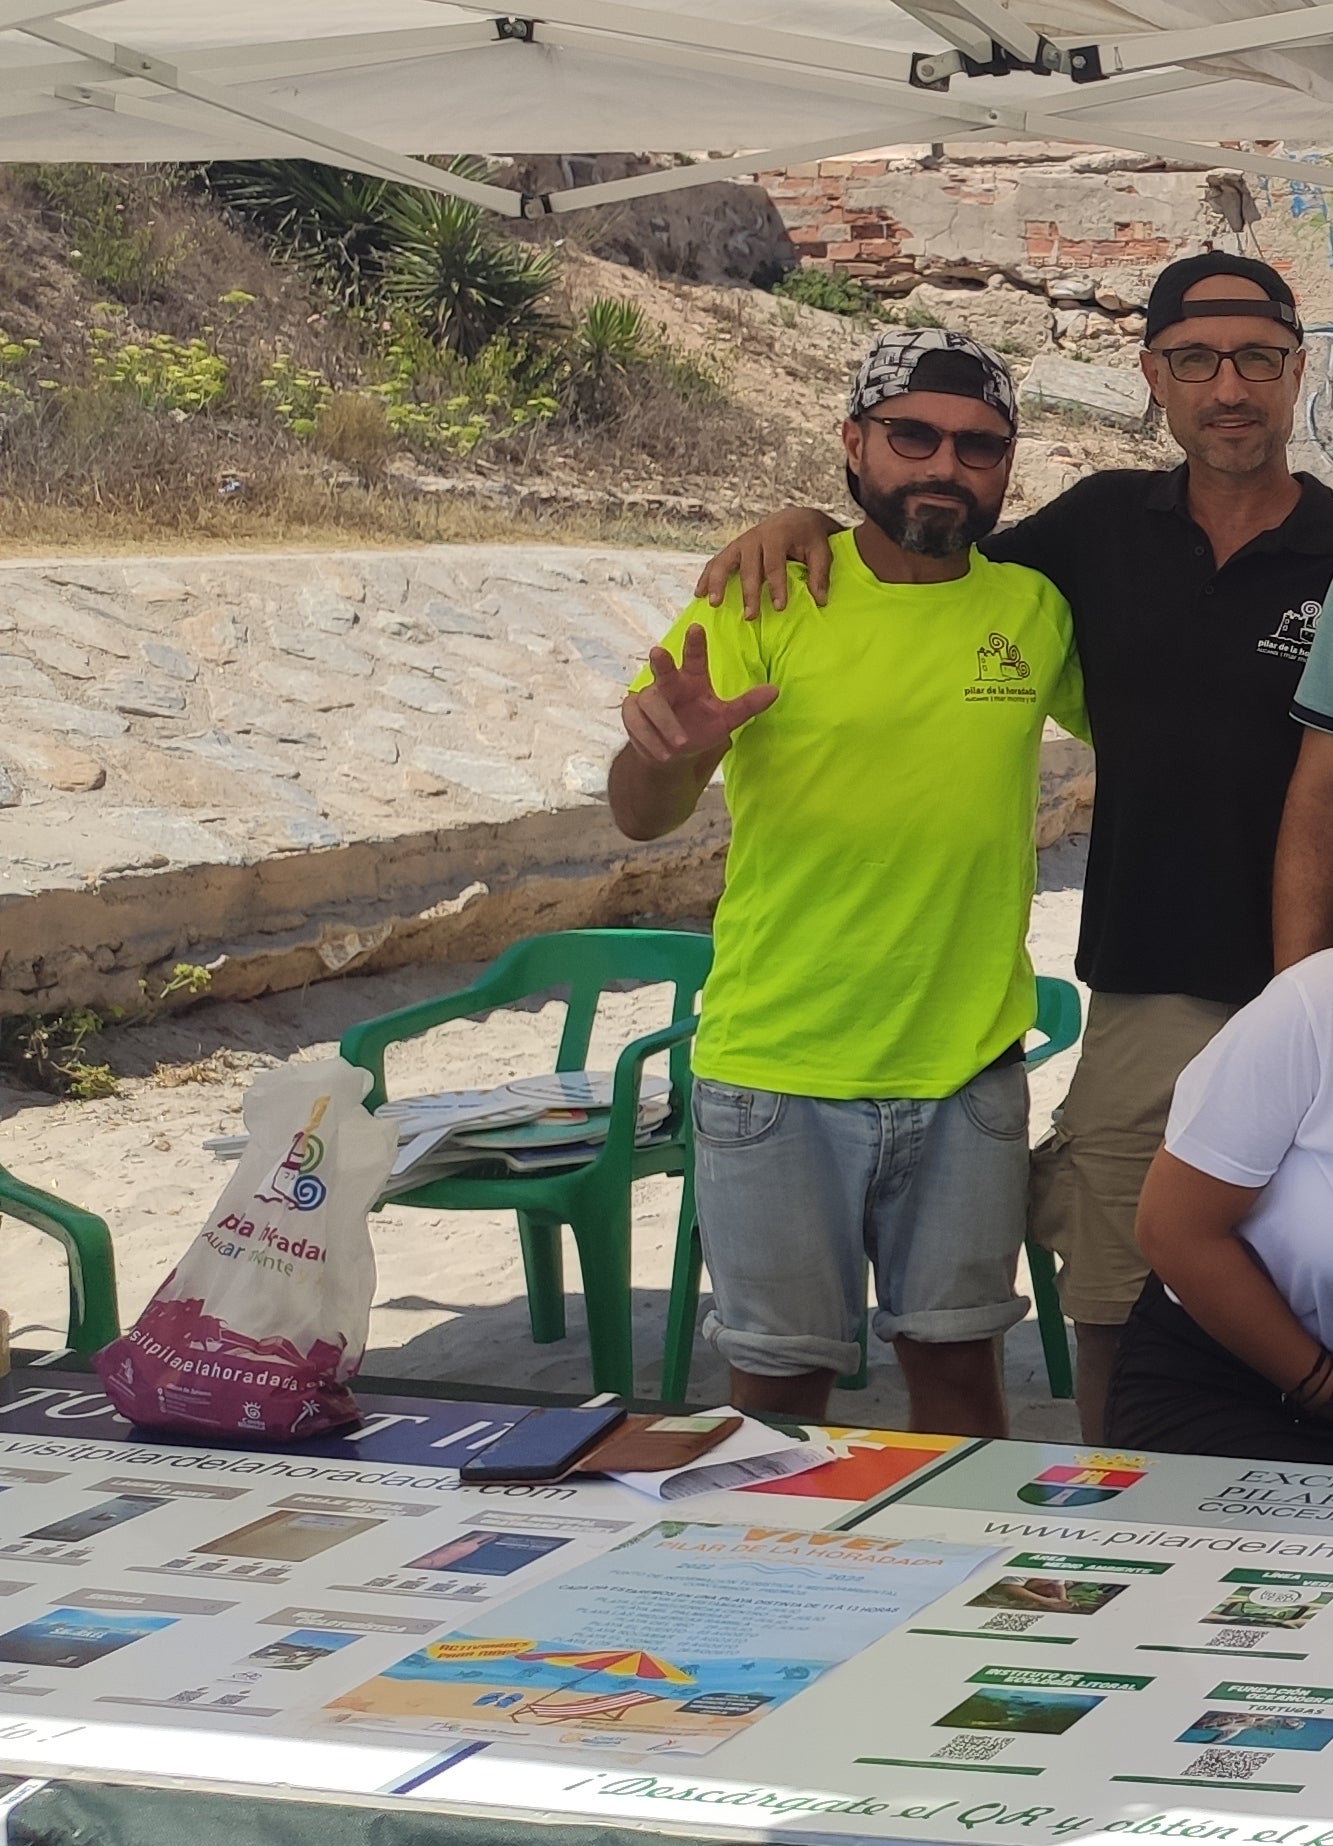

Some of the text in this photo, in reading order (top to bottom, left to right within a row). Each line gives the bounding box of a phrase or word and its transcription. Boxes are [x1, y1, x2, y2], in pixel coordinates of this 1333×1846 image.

[1258, 640, 1278, 649] pilar
[1279, 643, 1289, 651] de
[1290, 645, 1298, 654] la
[965, 686, 984, 696] pilar
[987, 686, 996, 694] de
[653, 1541, 944, 1566] PILAR DE LA HORADADA
[1087, 1565, 1154, 1574] AMBIENTE
[717, 1595, 749, 1604] PLAYA
[751, 1600, 798, 1610] DISTINTA
[984, 1668, 1085, 1681] INSTITUTO DE
[1077, 1680, 1139, 1691] LITORAL
[1227, 1684, 1312, 1696] FUNDACIÓN
[1247, 1705, 1327, 1715] TORTUGAS
[890, 1801, 960, 1820] el
[955, 1802, 1058, 1833] QR
[1050, 1815, 1094, 1836] y
[1095, 1815, 1240, 1842] obtén
[1253, 1823, 1297, 1844] el
